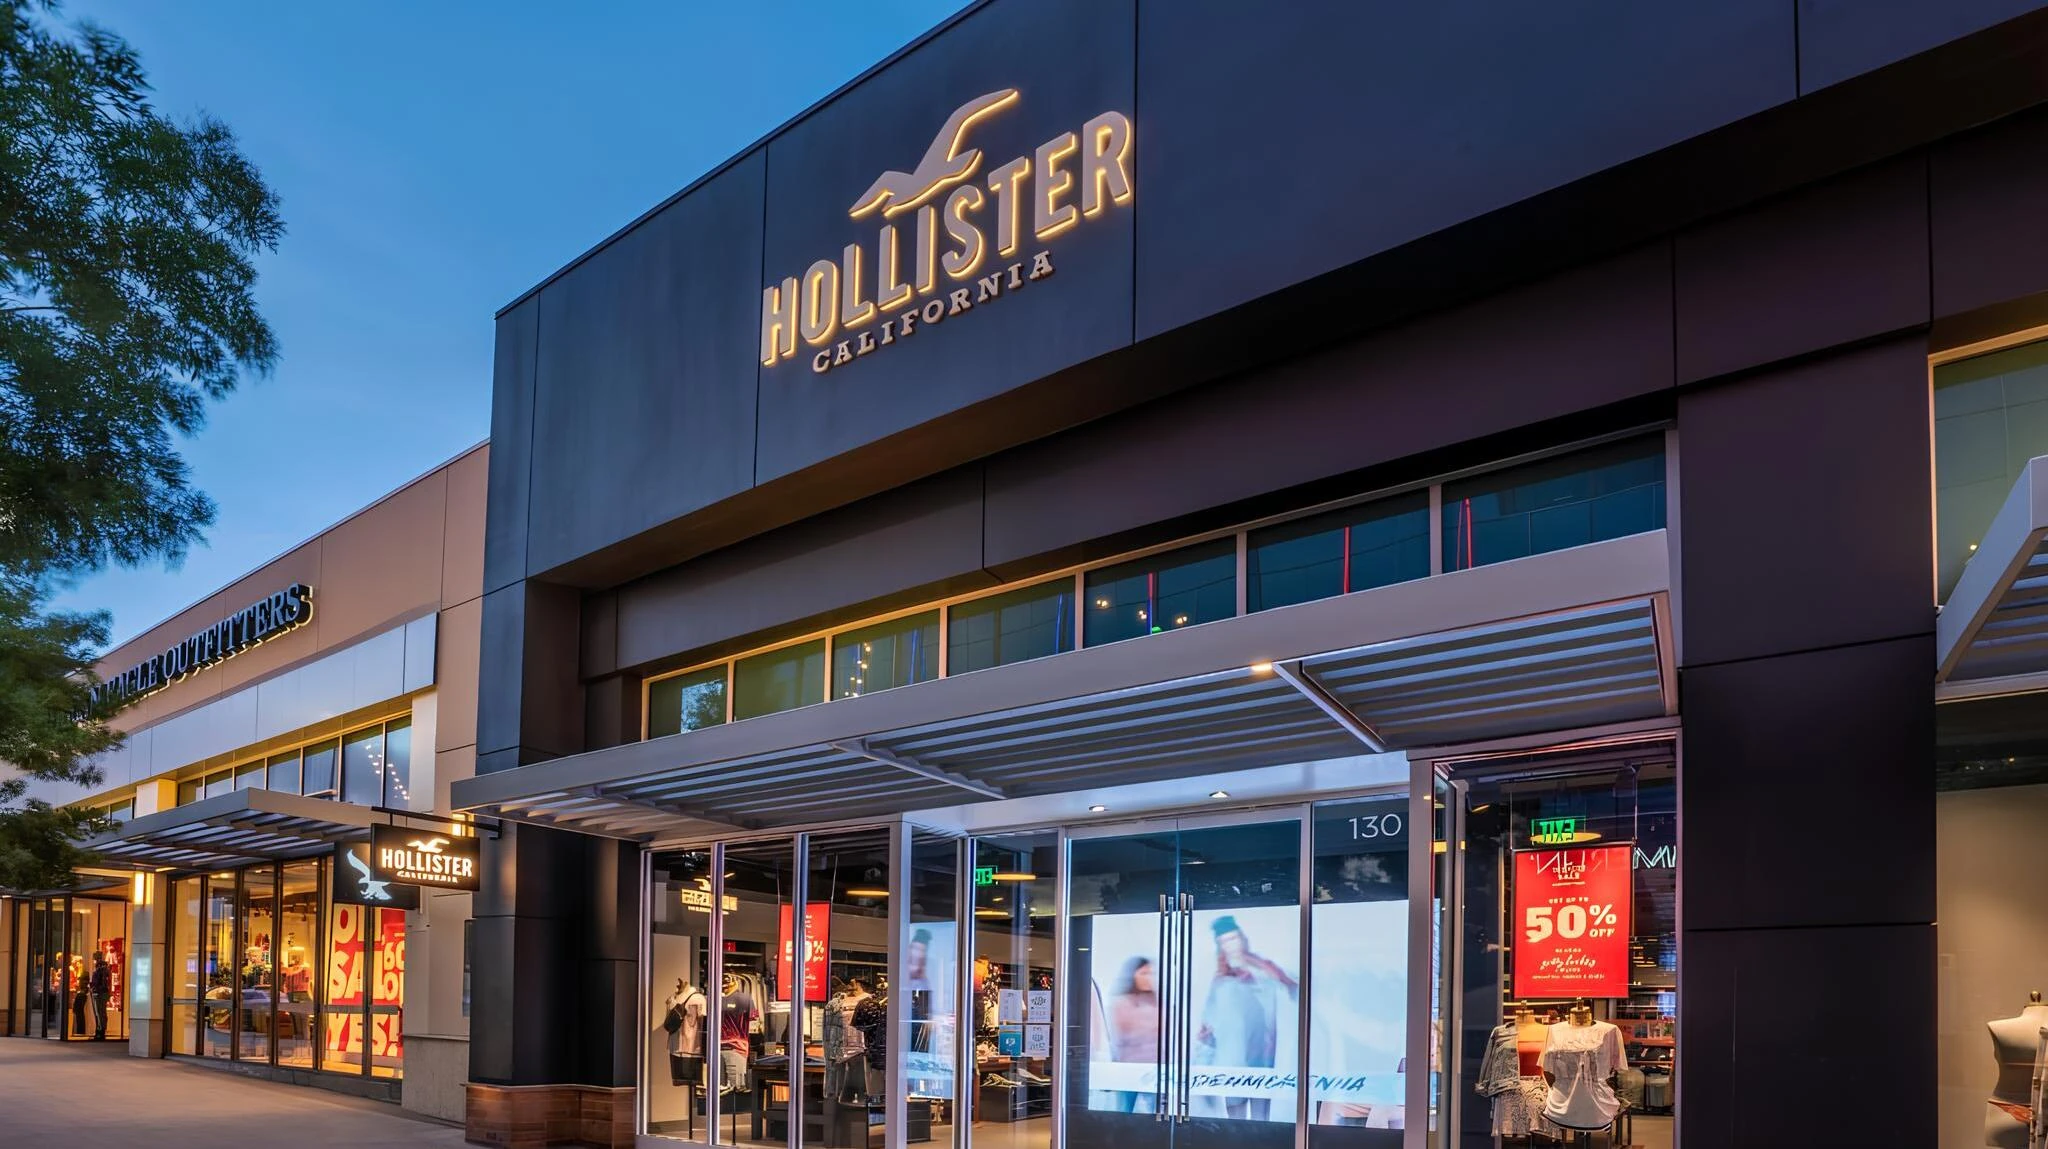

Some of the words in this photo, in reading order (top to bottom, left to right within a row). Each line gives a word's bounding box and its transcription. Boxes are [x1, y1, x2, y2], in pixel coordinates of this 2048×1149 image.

[760, 110, 1132, 367] HOLLISTER
[812, 250, 1056, 374] CALIFORNIA
[162, 582, 312, 681] OUTFITTERS
[1348, 813, 1402, 840] 130
[381, 848, 473, 878] HOLLISTER
[1526, 903, 1617, 943] 50%
[1589, 927, 1616, 938] OFF
